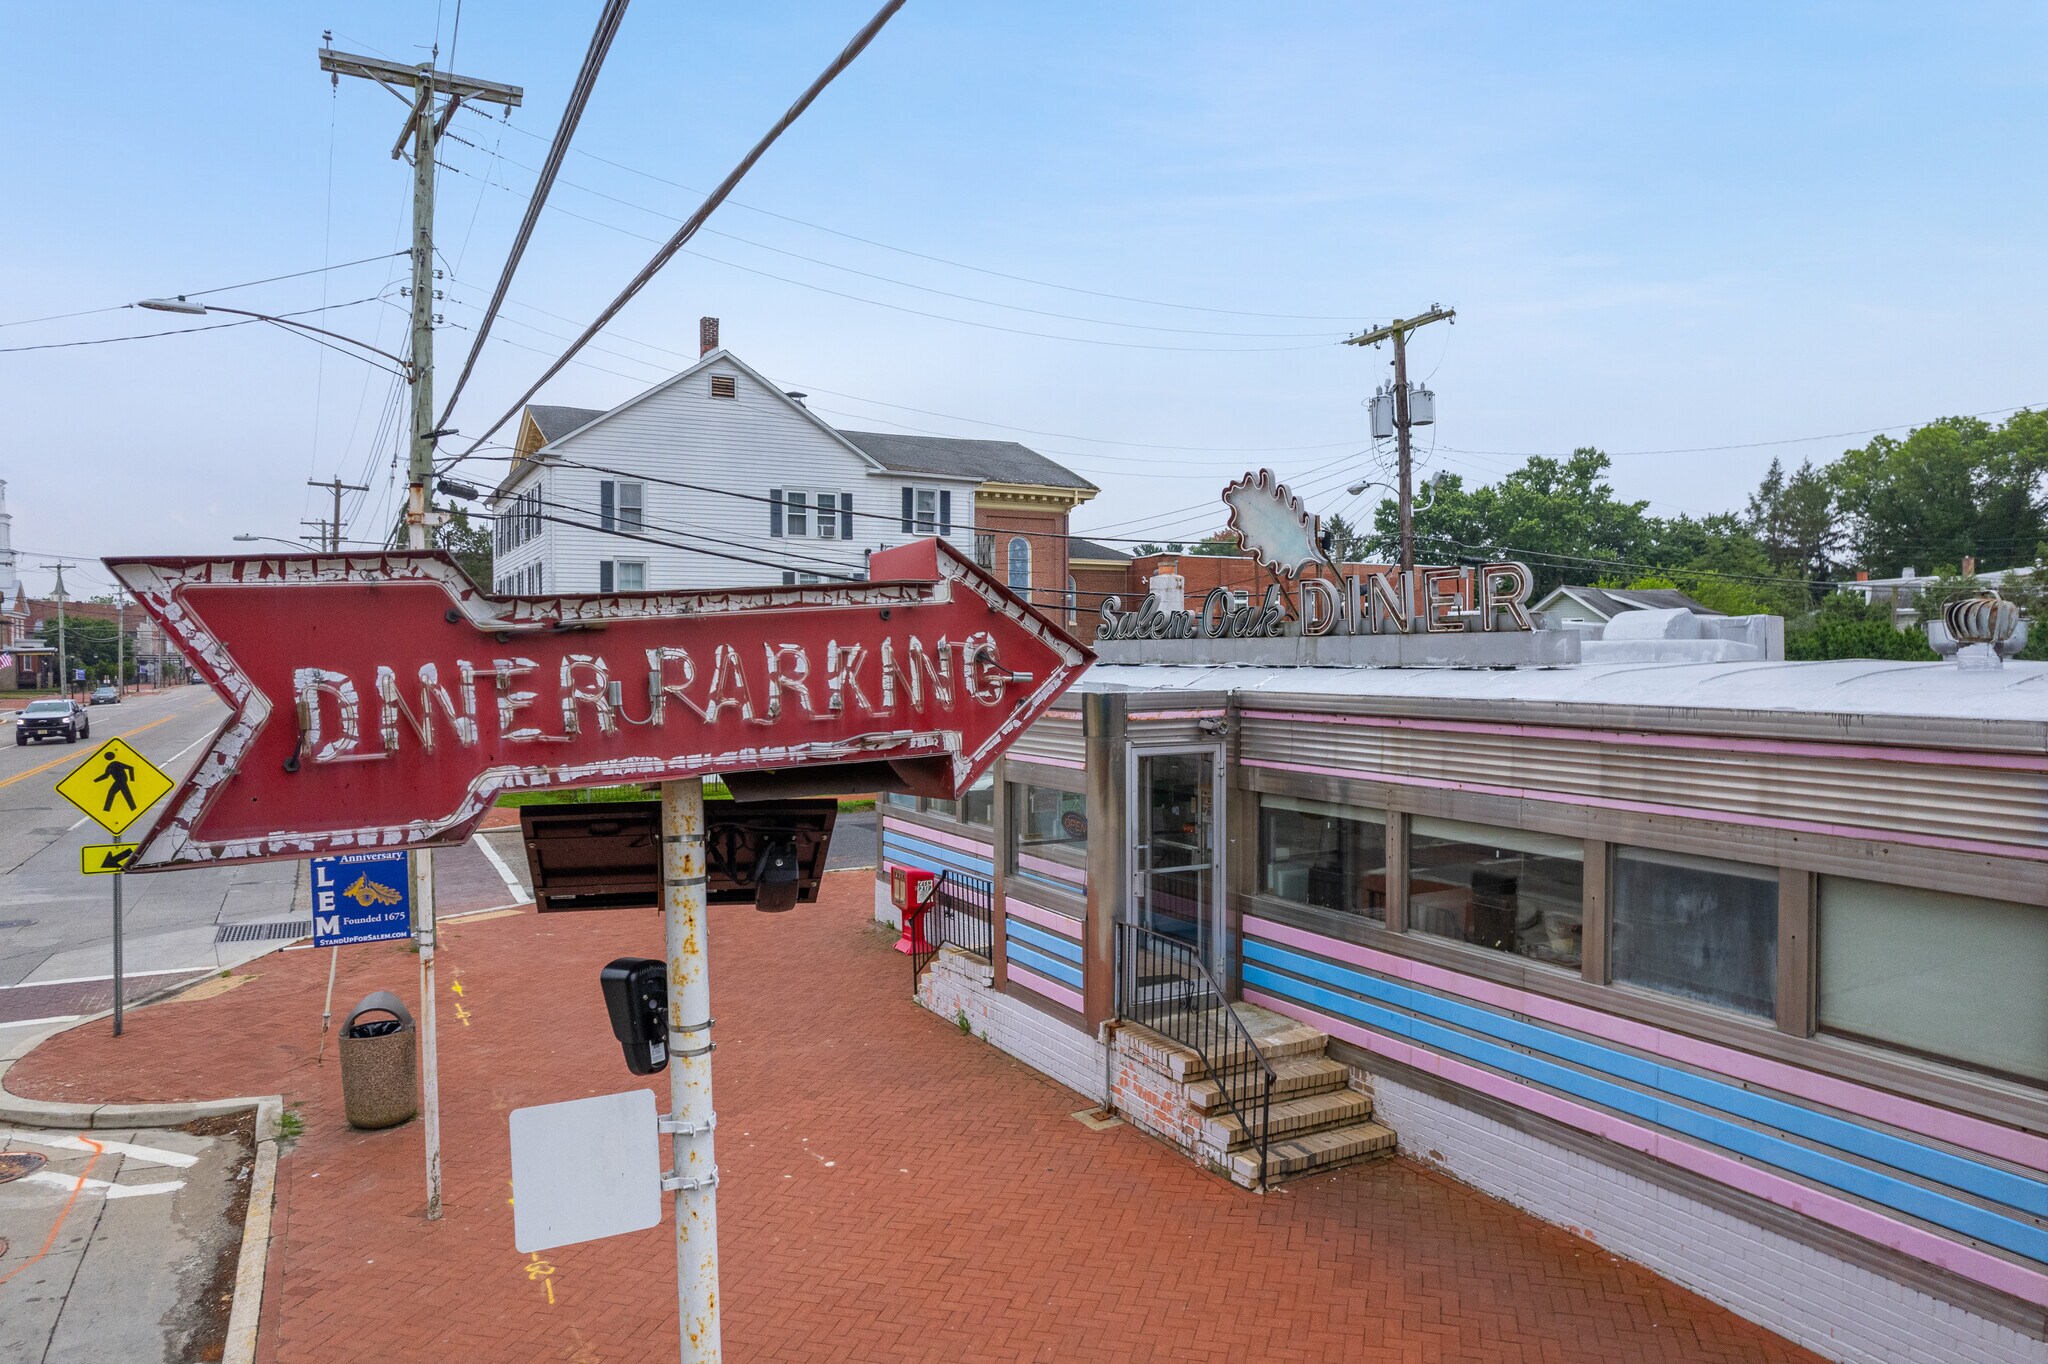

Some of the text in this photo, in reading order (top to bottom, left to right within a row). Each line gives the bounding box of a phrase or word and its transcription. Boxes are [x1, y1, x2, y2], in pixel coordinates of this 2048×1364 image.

[1096, 562, 1533, 641] Salem Oak DINER
[294, 631, 1005, 762] DINER PARKING
[340, 851, 403, 863] Anniversary
[343, 911, 405, 925] Founded 1675
